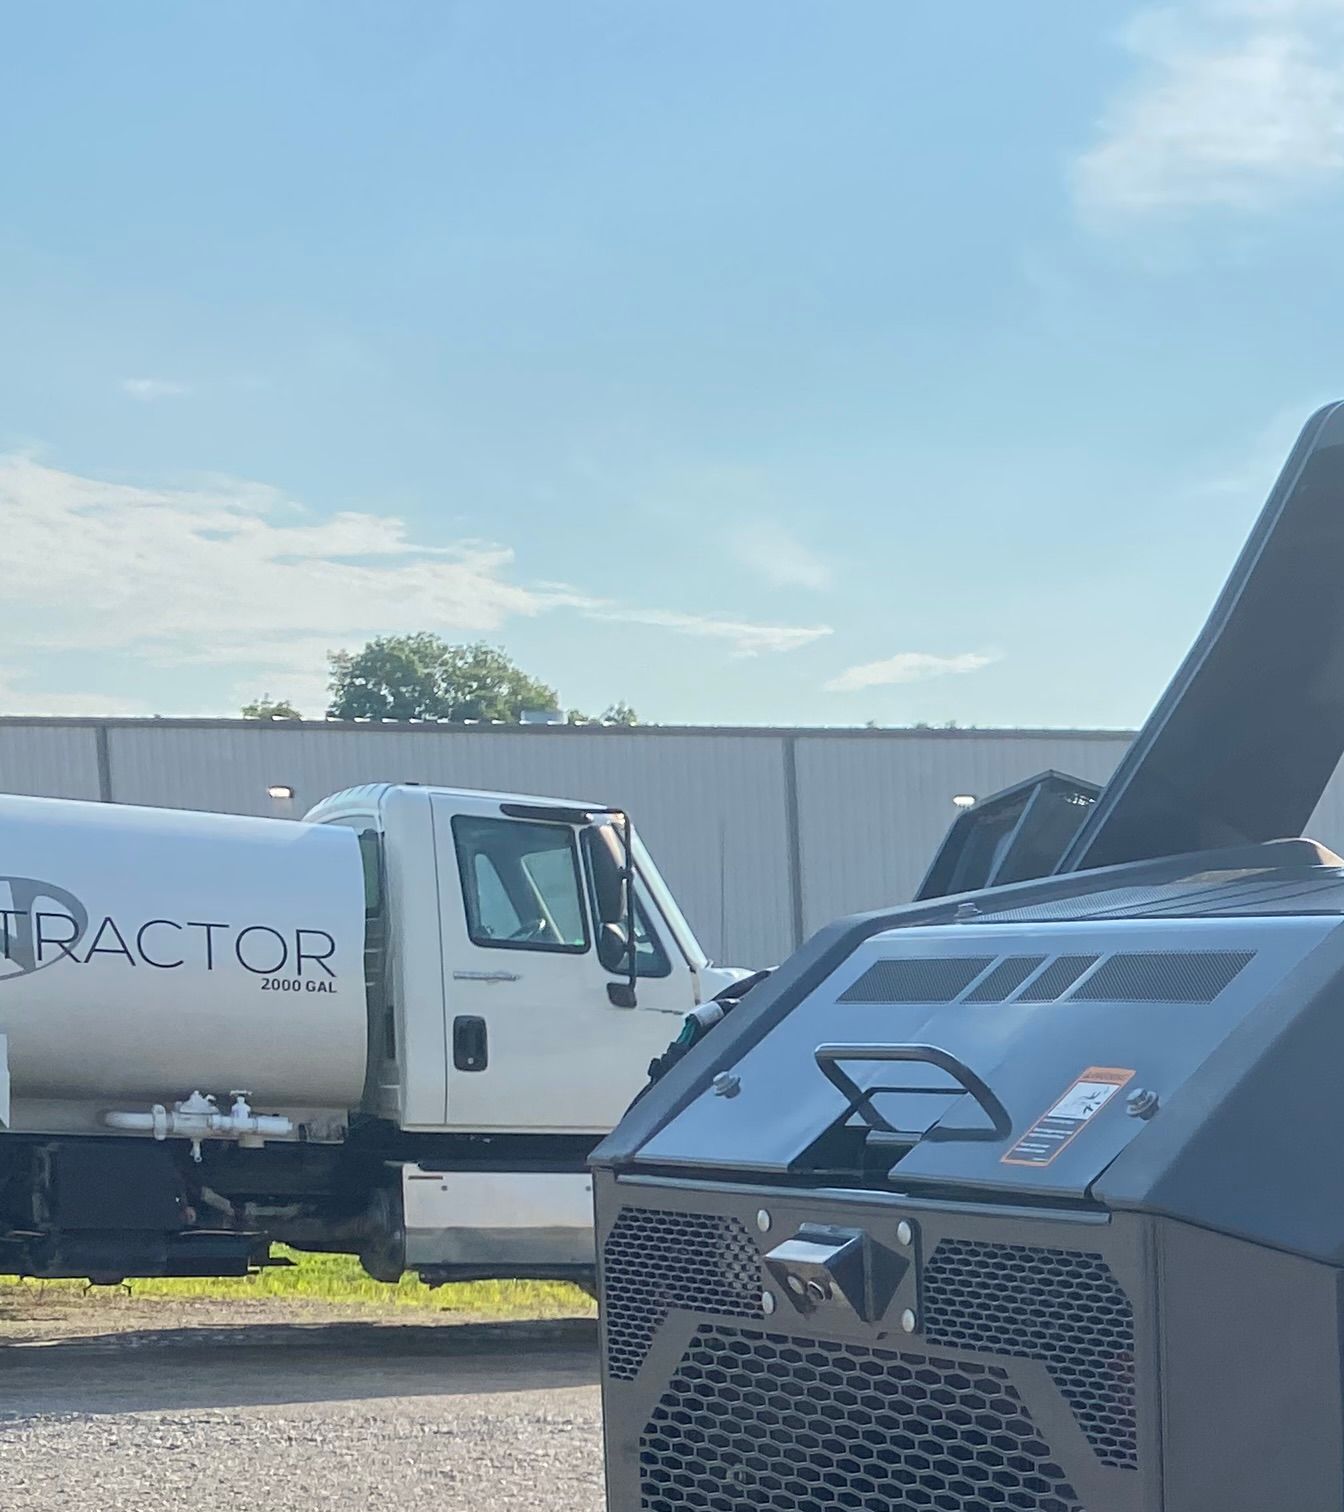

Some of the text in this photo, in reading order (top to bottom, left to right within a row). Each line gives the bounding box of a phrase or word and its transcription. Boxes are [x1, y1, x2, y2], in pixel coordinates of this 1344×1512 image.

[0, 909, 337, 977] TRACTOR
[261, 977, 337, 993] 2000 GAL
